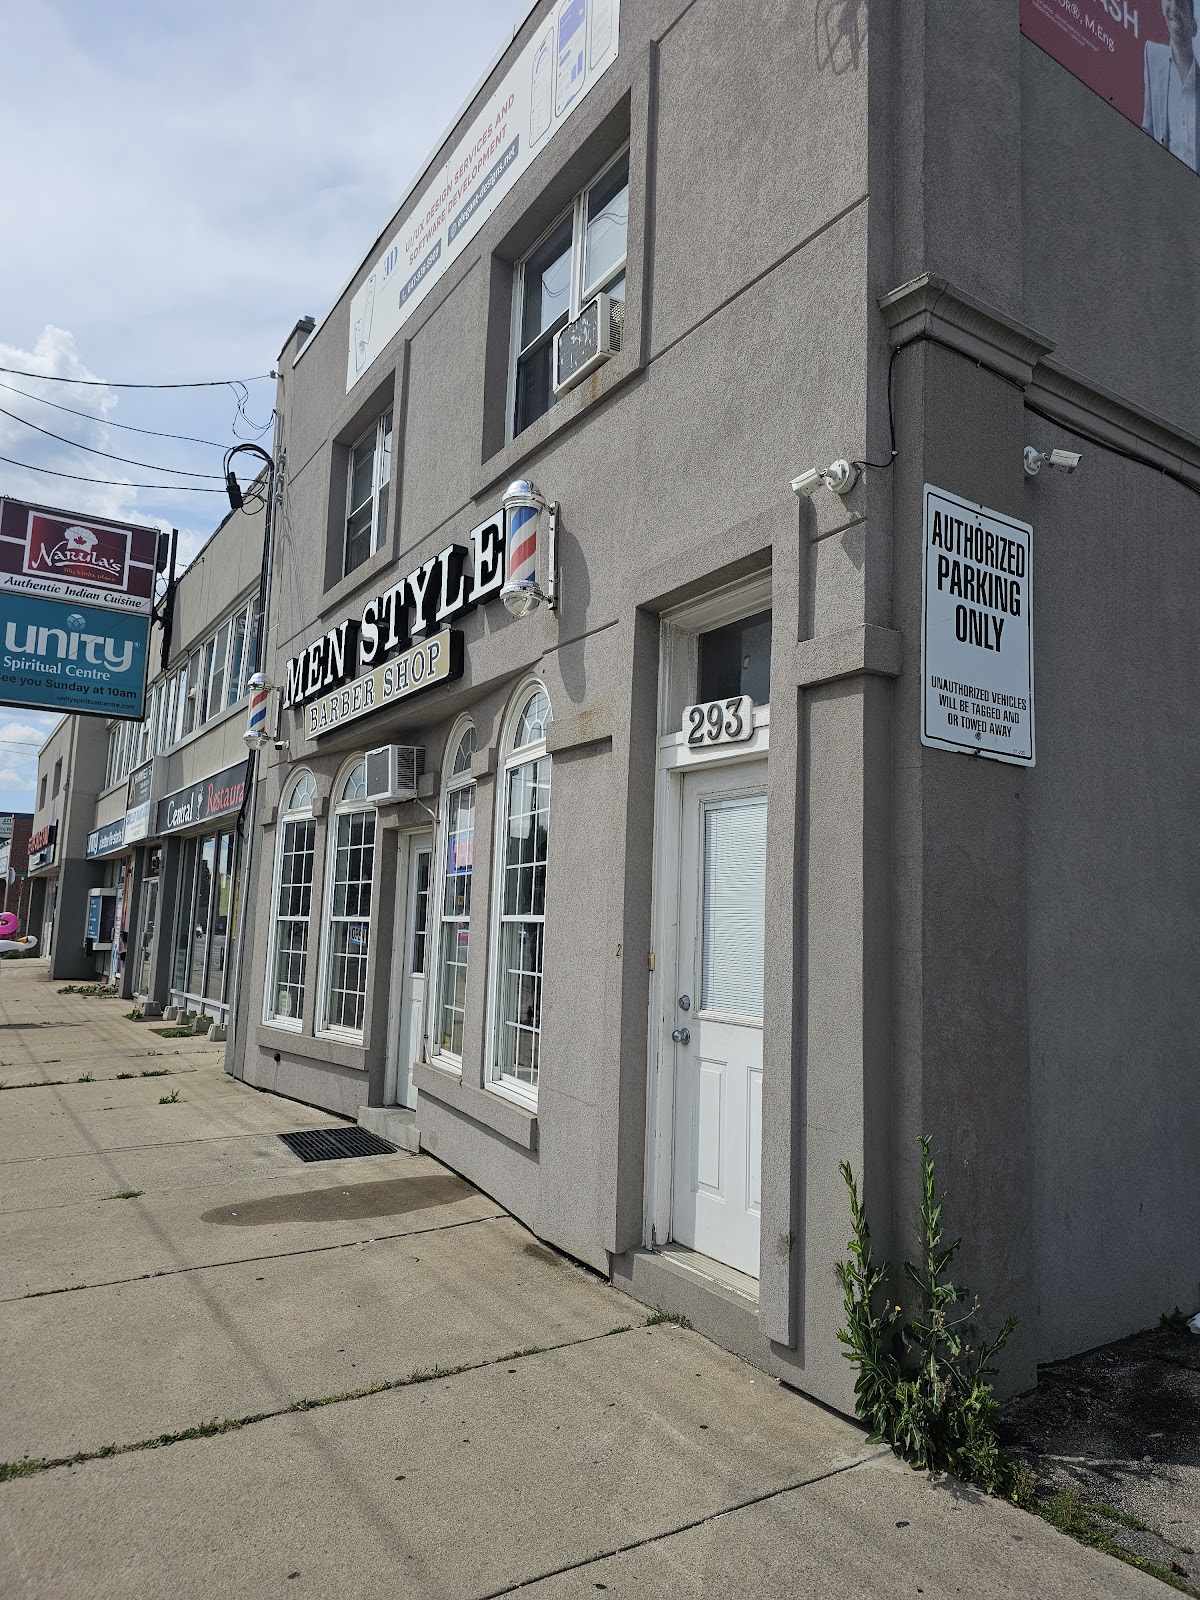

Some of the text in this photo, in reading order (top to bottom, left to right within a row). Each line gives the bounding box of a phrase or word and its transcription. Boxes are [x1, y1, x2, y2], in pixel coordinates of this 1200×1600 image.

[1085, 14, 1115, 52] M.Eng
[426, 181, 453, 223] DESIGN
[454, 124, 492, 184] SERVICES
[495, 93, 515, 129] AND
[409, 122, 507, 265] SOFTWARE DEVELOPMENT
[31, 541, 122, 572] Narula's
[932, 510, 1025, 578] AUTHORIZED
[4, 576, 142, 608] Authentic Indian Cuisine
[937, 553, 1021, 617] PARKING
[282, 508, 506, 710] MEN STYLE
[955, 604, 1004, 652] ONLY
[3, 656, 111, 680] Spiritual Centre
[20, 677, 41, 687] you
[45, 679, 90, 694] Sunday
[93, 685, 104, 695] at
[108, 687, 137, 698] 10am
[309, 640, 442, 733] BARBER SHOP
[931, 675, 1027, 711] UNAUTHORIZED VEHICLES
[939, 693, 1020, 724] WILL BE TAGGED AND
[687, 697, 743, 744] 293
[947, 713, 1012, 738] OR TOWED AWAY
[167, 792, 195, 828] Central
[206, 781, 246, 816] Restaura
